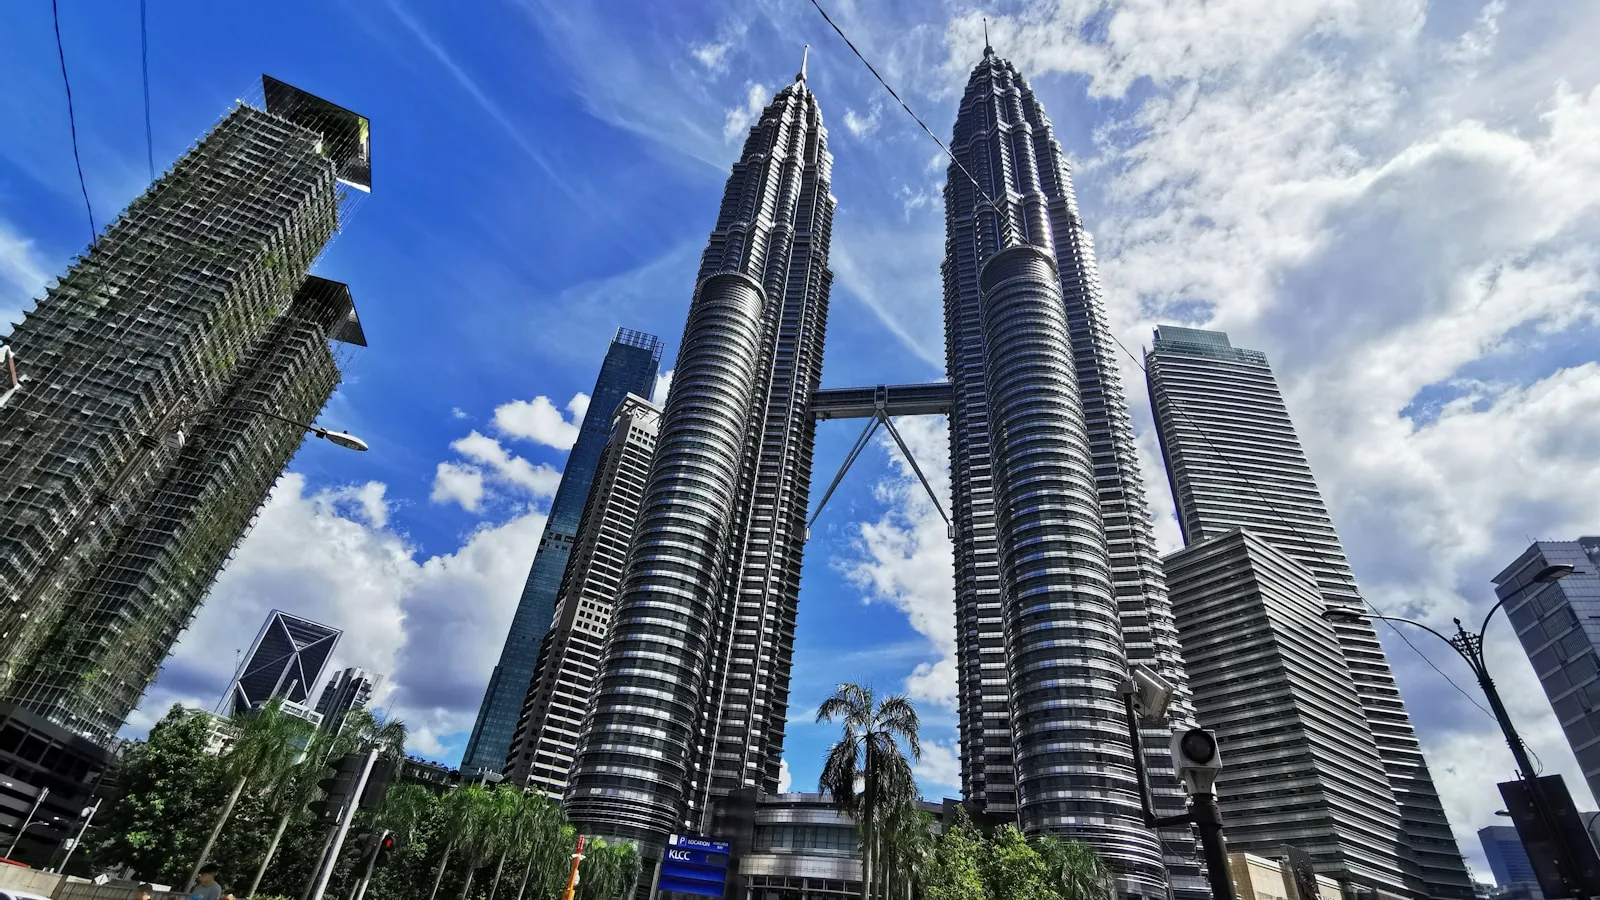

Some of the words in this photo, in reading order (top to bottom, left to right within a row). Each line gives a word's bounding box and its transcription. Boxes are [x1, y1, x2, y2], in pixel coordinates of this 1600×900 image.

[679, 836, 686, 845] P
[688, 839, 711, 847] LOCATION
[668, 849, 691, 861] KLCC
